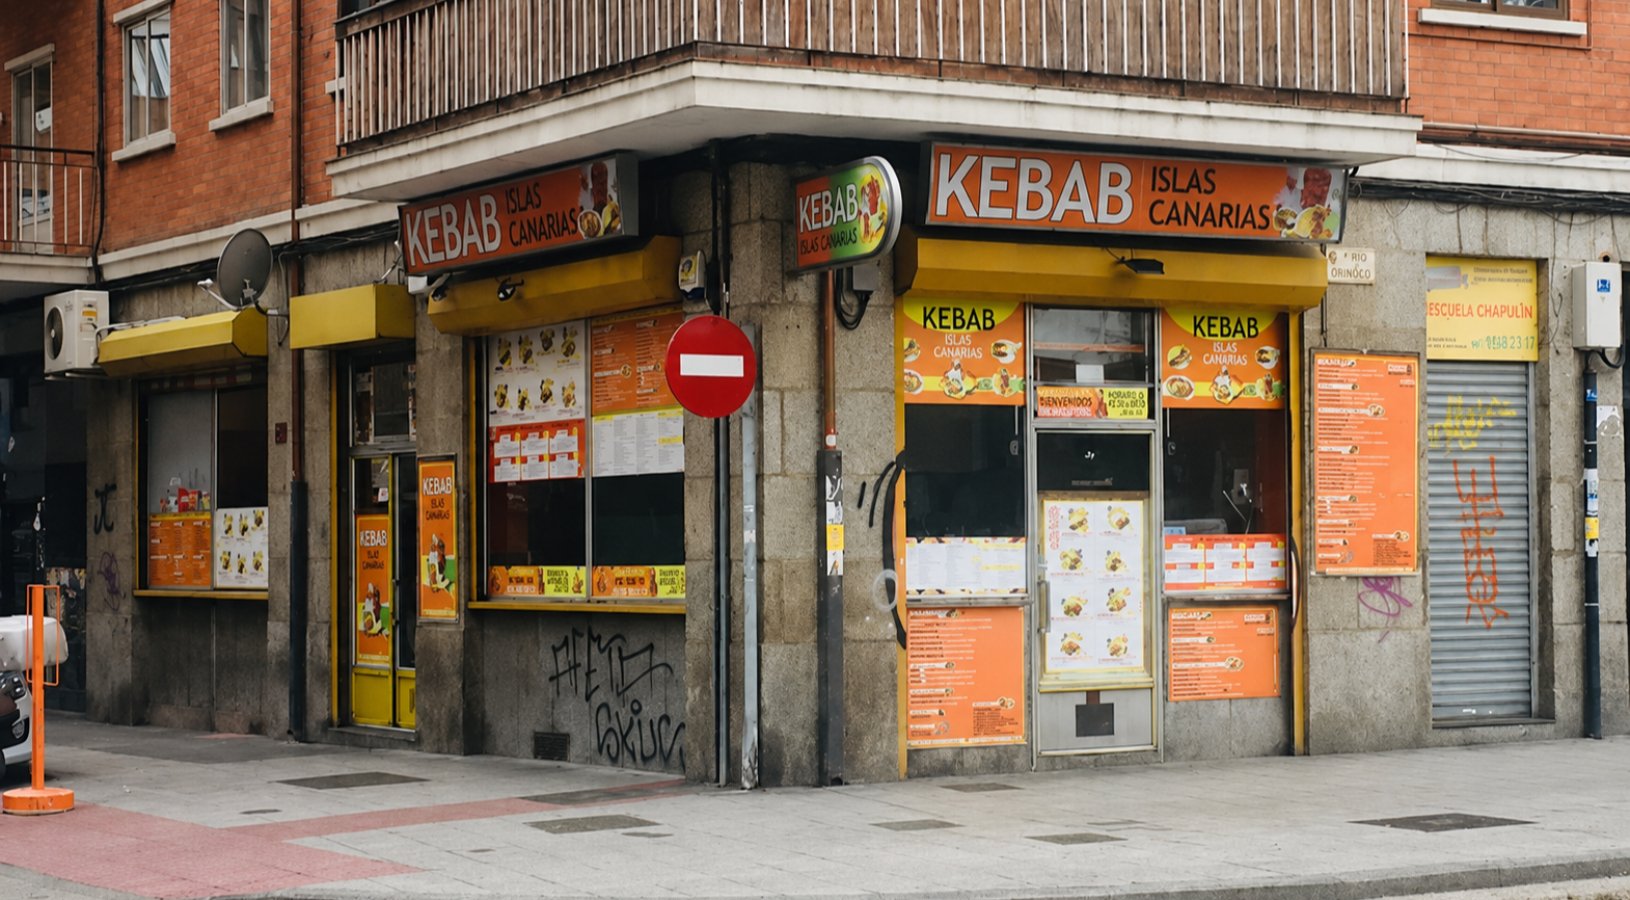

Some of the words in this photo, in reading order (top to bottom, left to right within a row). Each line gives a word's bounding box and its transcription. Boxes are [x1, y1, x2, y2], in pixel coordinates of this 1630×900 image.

[935, 153, 1134, 225] KEBAB
[1151, 165, 1216, 195] ISLAS
[505, 181, 542, 215] ISLAS
[799, 183, 858, 234] KEBAB
[509, 207, 579, 247] CANARIAS
[1149, 199, 1271, 231] CANARIAS
[405, 194, 502, 267] KEBAB
[800, 235, 819, 255] ISLAS
[820, 227, 858, 252] CANARIAS
[1351, 252, 1367, 262] RIO
[1331, 267, 1371, 279] ORINOCO
[923, 306, 996, 331] KEBAB
[1193, 315, 1259, 339] KEBAB
[945, 333, 972, 346] ISLAS
[1213, 342, 1238, 353] ISLAS
[933, 346, 983, 359] CANARIAS
[1203, 353, 1248, 366] CANARIAS
[422, 476, 453, 496] KEBAB
[360, 530, 388, 547] KEBAB
